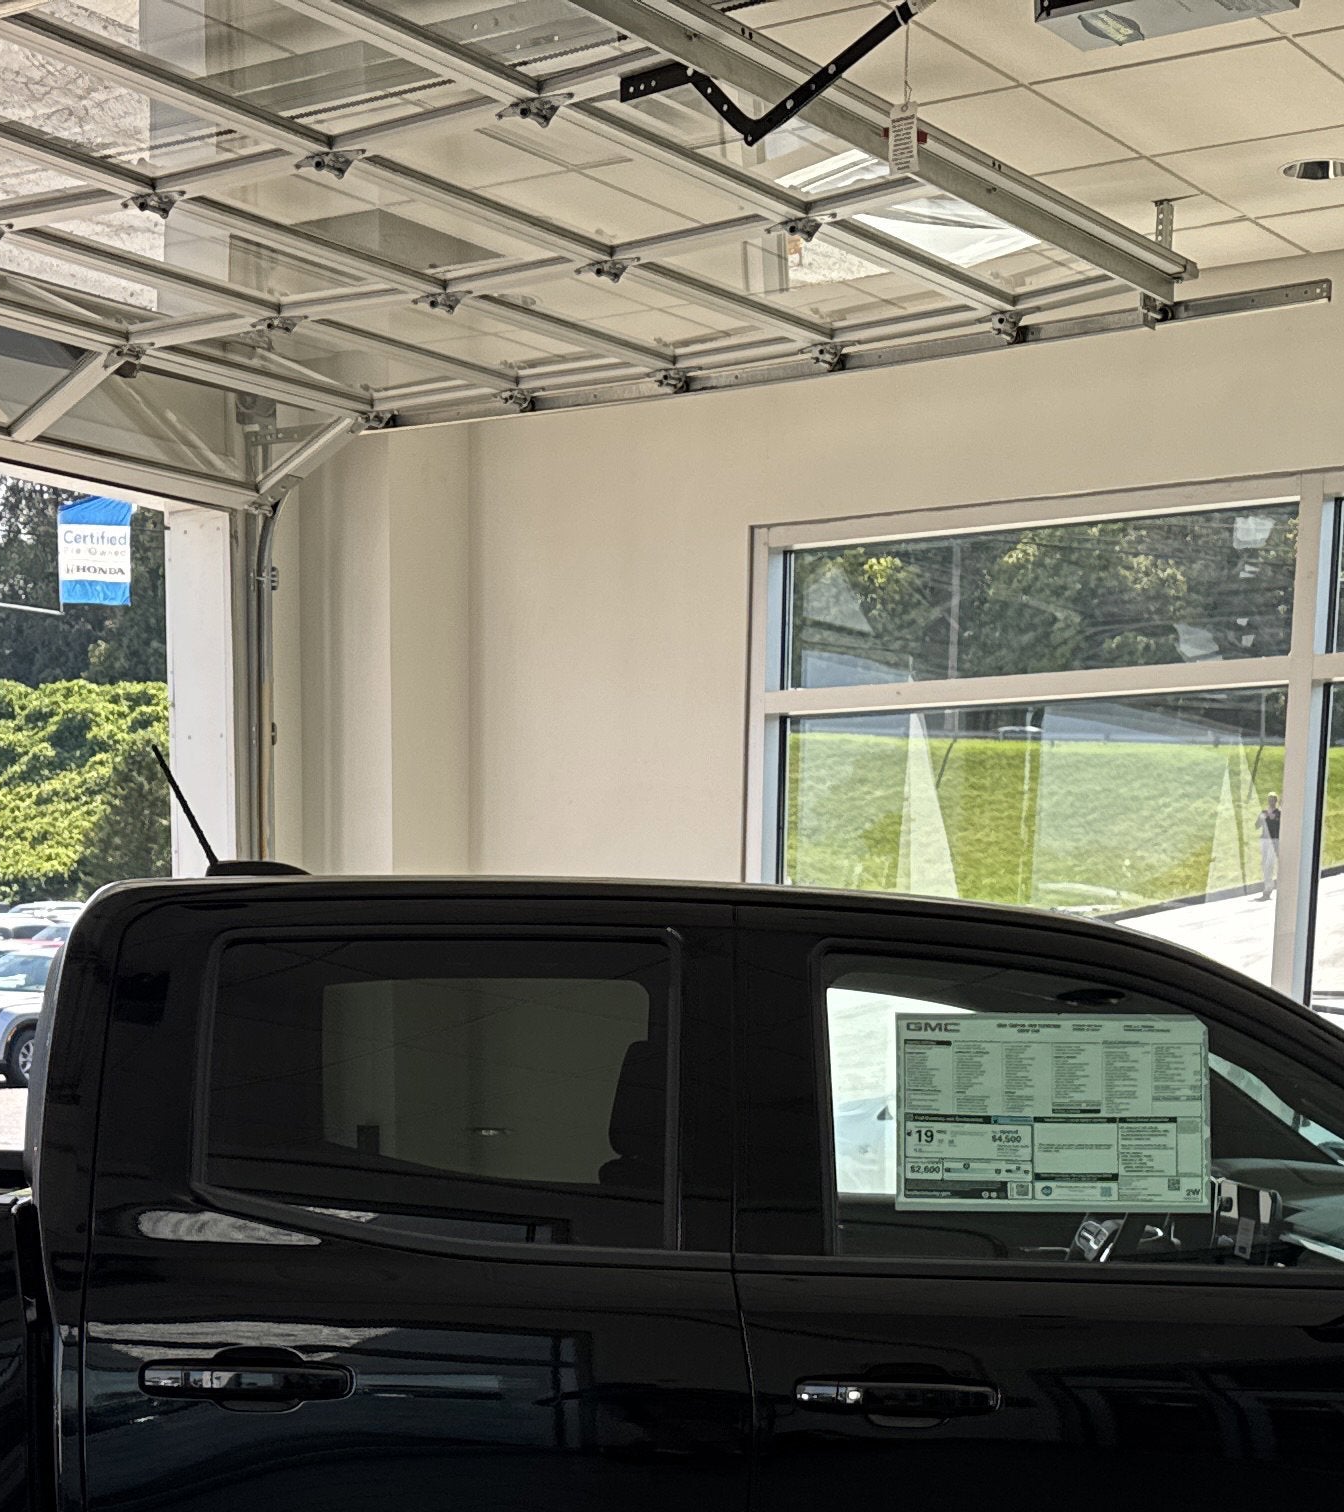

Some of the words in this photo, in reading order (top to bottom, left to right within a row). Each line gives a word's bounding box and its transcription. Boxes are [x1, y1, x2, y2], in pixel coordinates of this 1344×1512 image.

[63, 530, 127, 546] Certified
[76, 565, 126, 575] HONDA
[906, 1021, 960, 1033] GMC
[916, 1130, 934, 1143] 19
[991, 1135, 1022, 1144] $4,500
